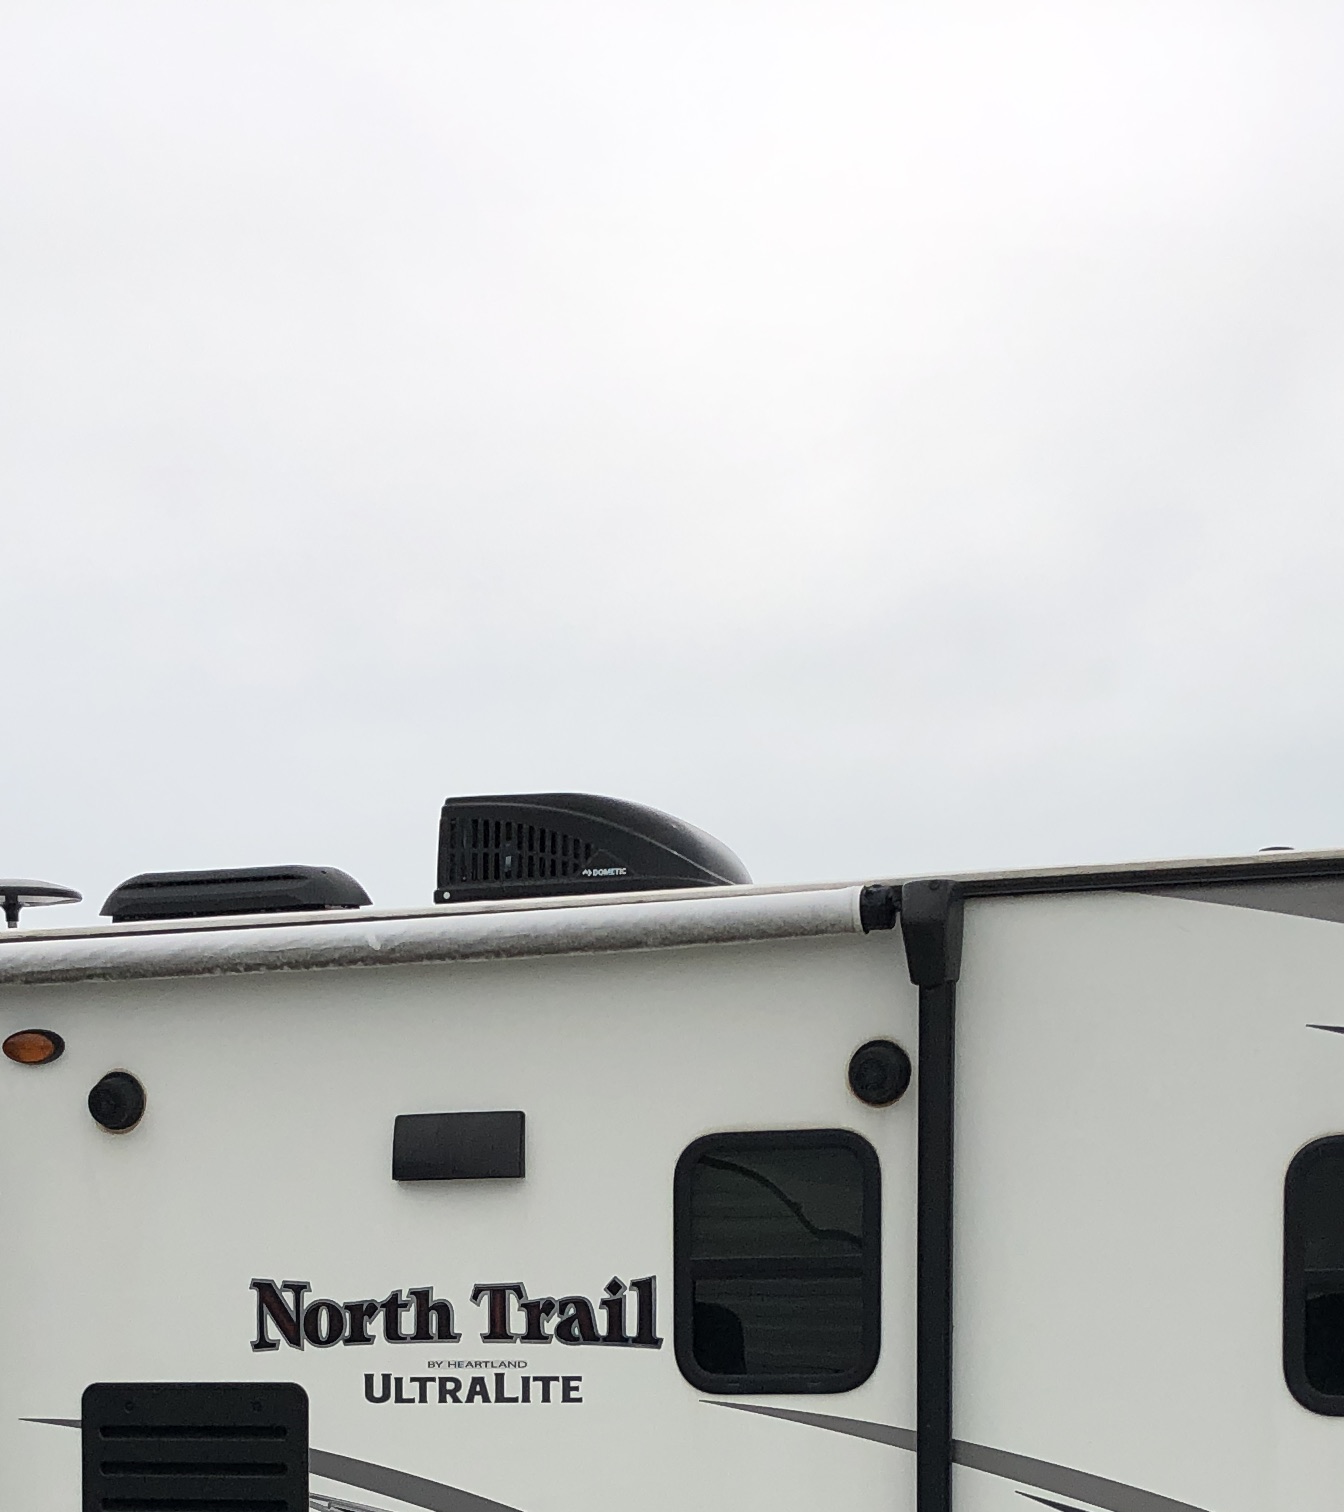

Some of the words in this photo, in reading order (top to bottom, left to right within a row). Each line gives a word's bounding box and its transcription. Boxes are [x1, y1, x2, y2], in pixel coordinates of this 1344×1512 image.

[592, 867, 627, 877] DOMETIC
[249, 1277, 461, 1353] North
[469, 1275, 663, 1349] Trail
[427, 1360, 444, 1369] BY
[447, 1360, 528, 1369] HEARTLAND
